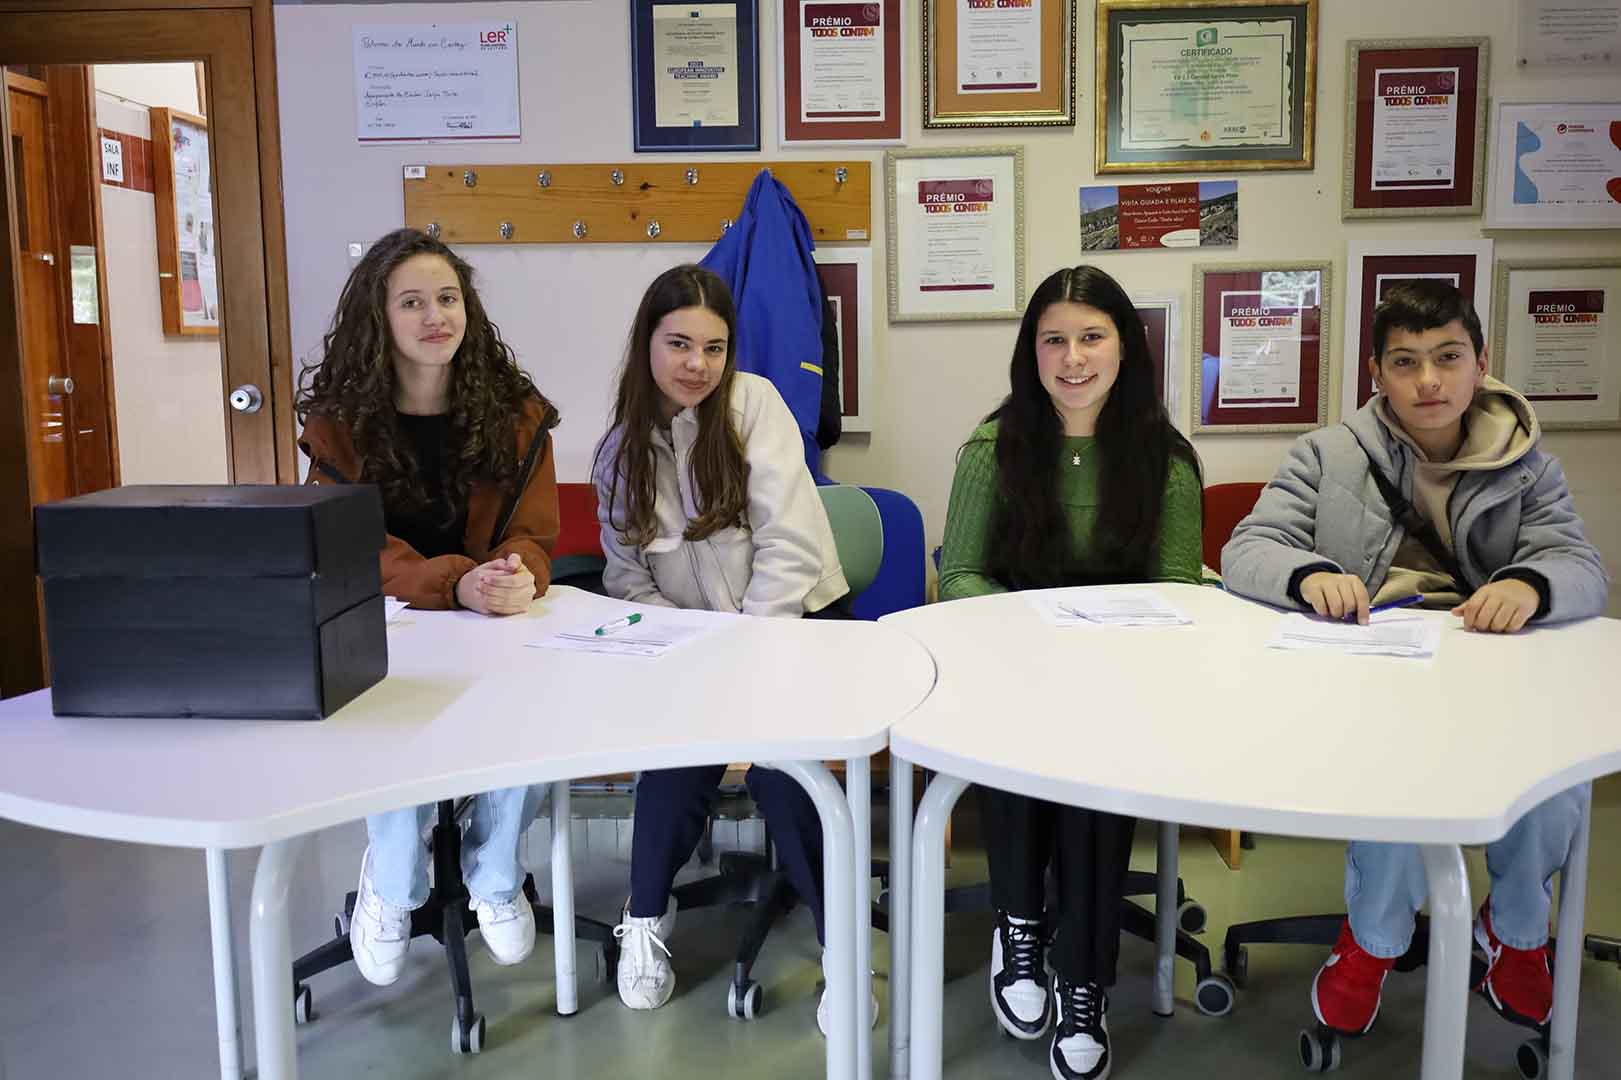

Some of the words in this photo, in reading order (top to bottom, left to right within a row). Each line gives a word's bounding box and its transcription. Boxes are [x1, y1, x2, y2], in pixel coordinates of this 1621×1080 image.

[812, 16, 852, 26] PRÉMIO
[810, 28, 838, 38] TODOS
[840, 27, 875, 37] CONTAM
[1180, 47, 1233, 57] CERTIFICADO
[1386, 85, 1426, 95] PRÉMIO
[1384, 96, 1412, 106] TODOS
[1414, 95, 1448, 106] CONTAM
[104, 143, 119, 155] SALA
[106, 161, 119, 176] INF
[926, 192, 965, 202] PRÉMIO
[924, 203, 952, 213] TODOS
[953, 203, 988, 213] CONTAM
[1231, 306, 1271, 316] PRÉMIO
[1229, 318, 1256, 327] TODOS
[1258, 317, 1293, 327] CONTAM
[1534, 314, 1561, 324] TODOS
[1563, 313, 1598, 323] CONTAM
